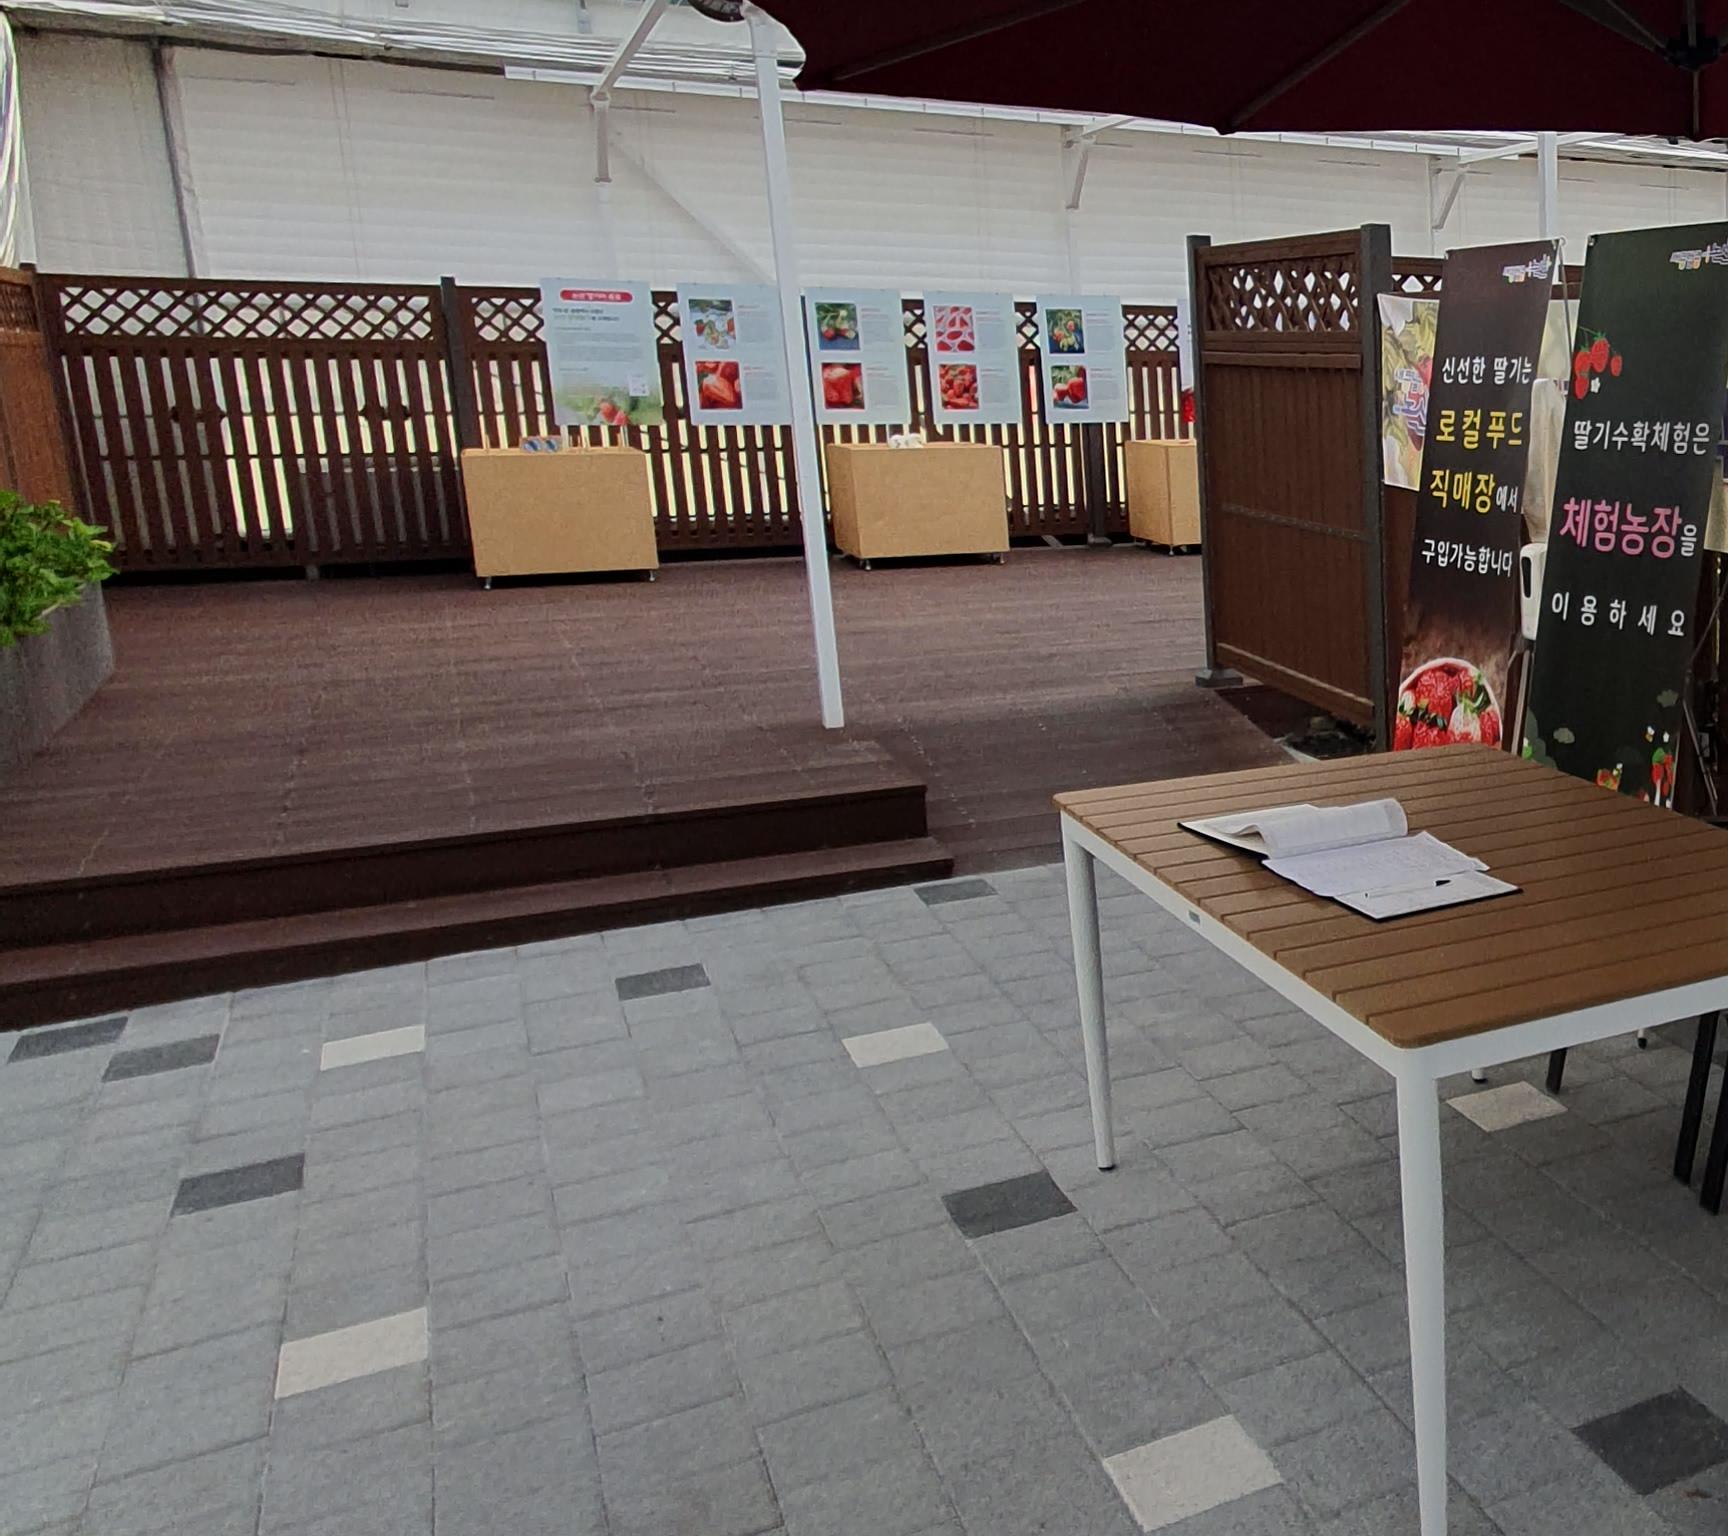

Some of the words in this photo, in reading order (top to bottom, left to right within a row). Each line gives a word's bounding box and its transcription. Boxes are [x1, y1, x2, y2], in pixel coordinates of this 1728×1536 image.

[1441, 355, 1486, 384] 신선한
[1494, 356, 1533, 385] 딸기는
[1435, 408, 1523, 449] 로컬푸드
[1574, 420, 1710, 455] 딸기수확체험은
[1430, 468, 1519, 514] 직매장에서
[1560, 497, 1698, 558] 체험농장을
[1421, 538, 1513, 578] 구입가능합니다
